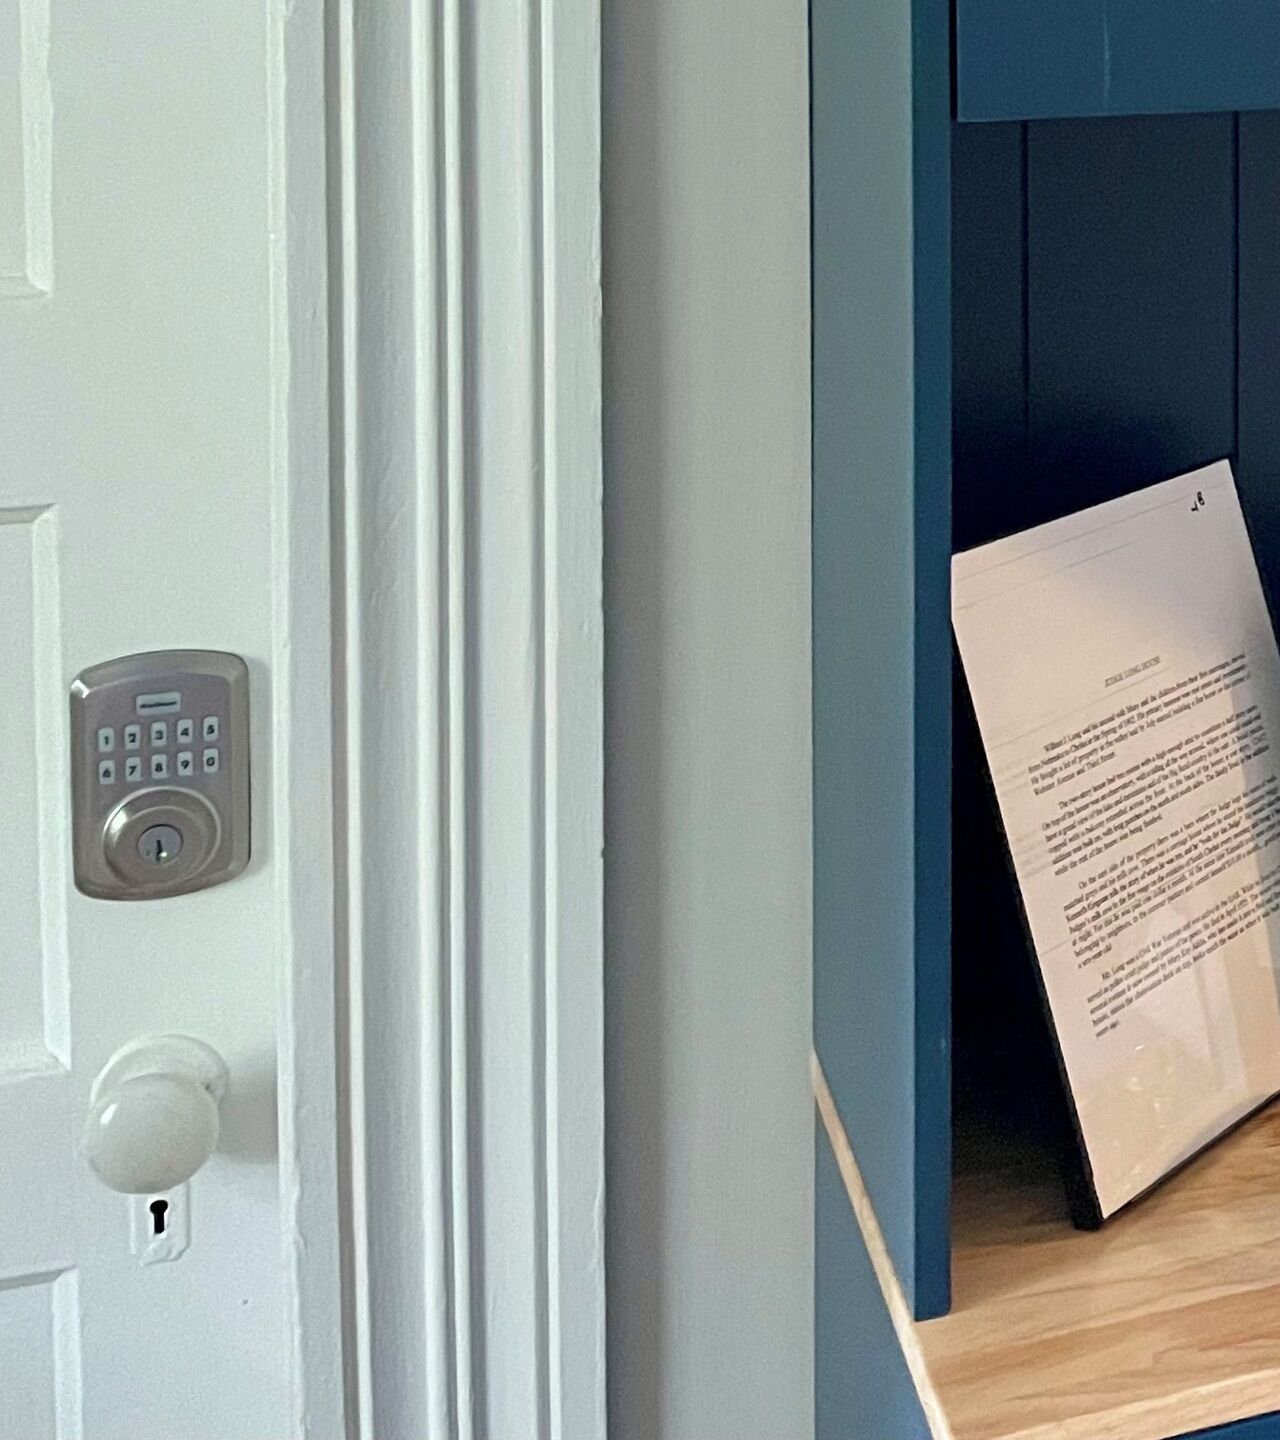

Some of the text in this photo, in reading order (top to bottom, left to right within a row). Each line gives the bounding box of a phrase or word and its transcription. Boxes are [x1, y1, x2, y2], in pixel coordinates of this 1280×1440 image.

[103, 724, 215, 746] 1 2 3 4 5
[129, 764, 138, 777] 7
[155, 762, 164, 773] 8
[180, 760, 190, 770] 9
